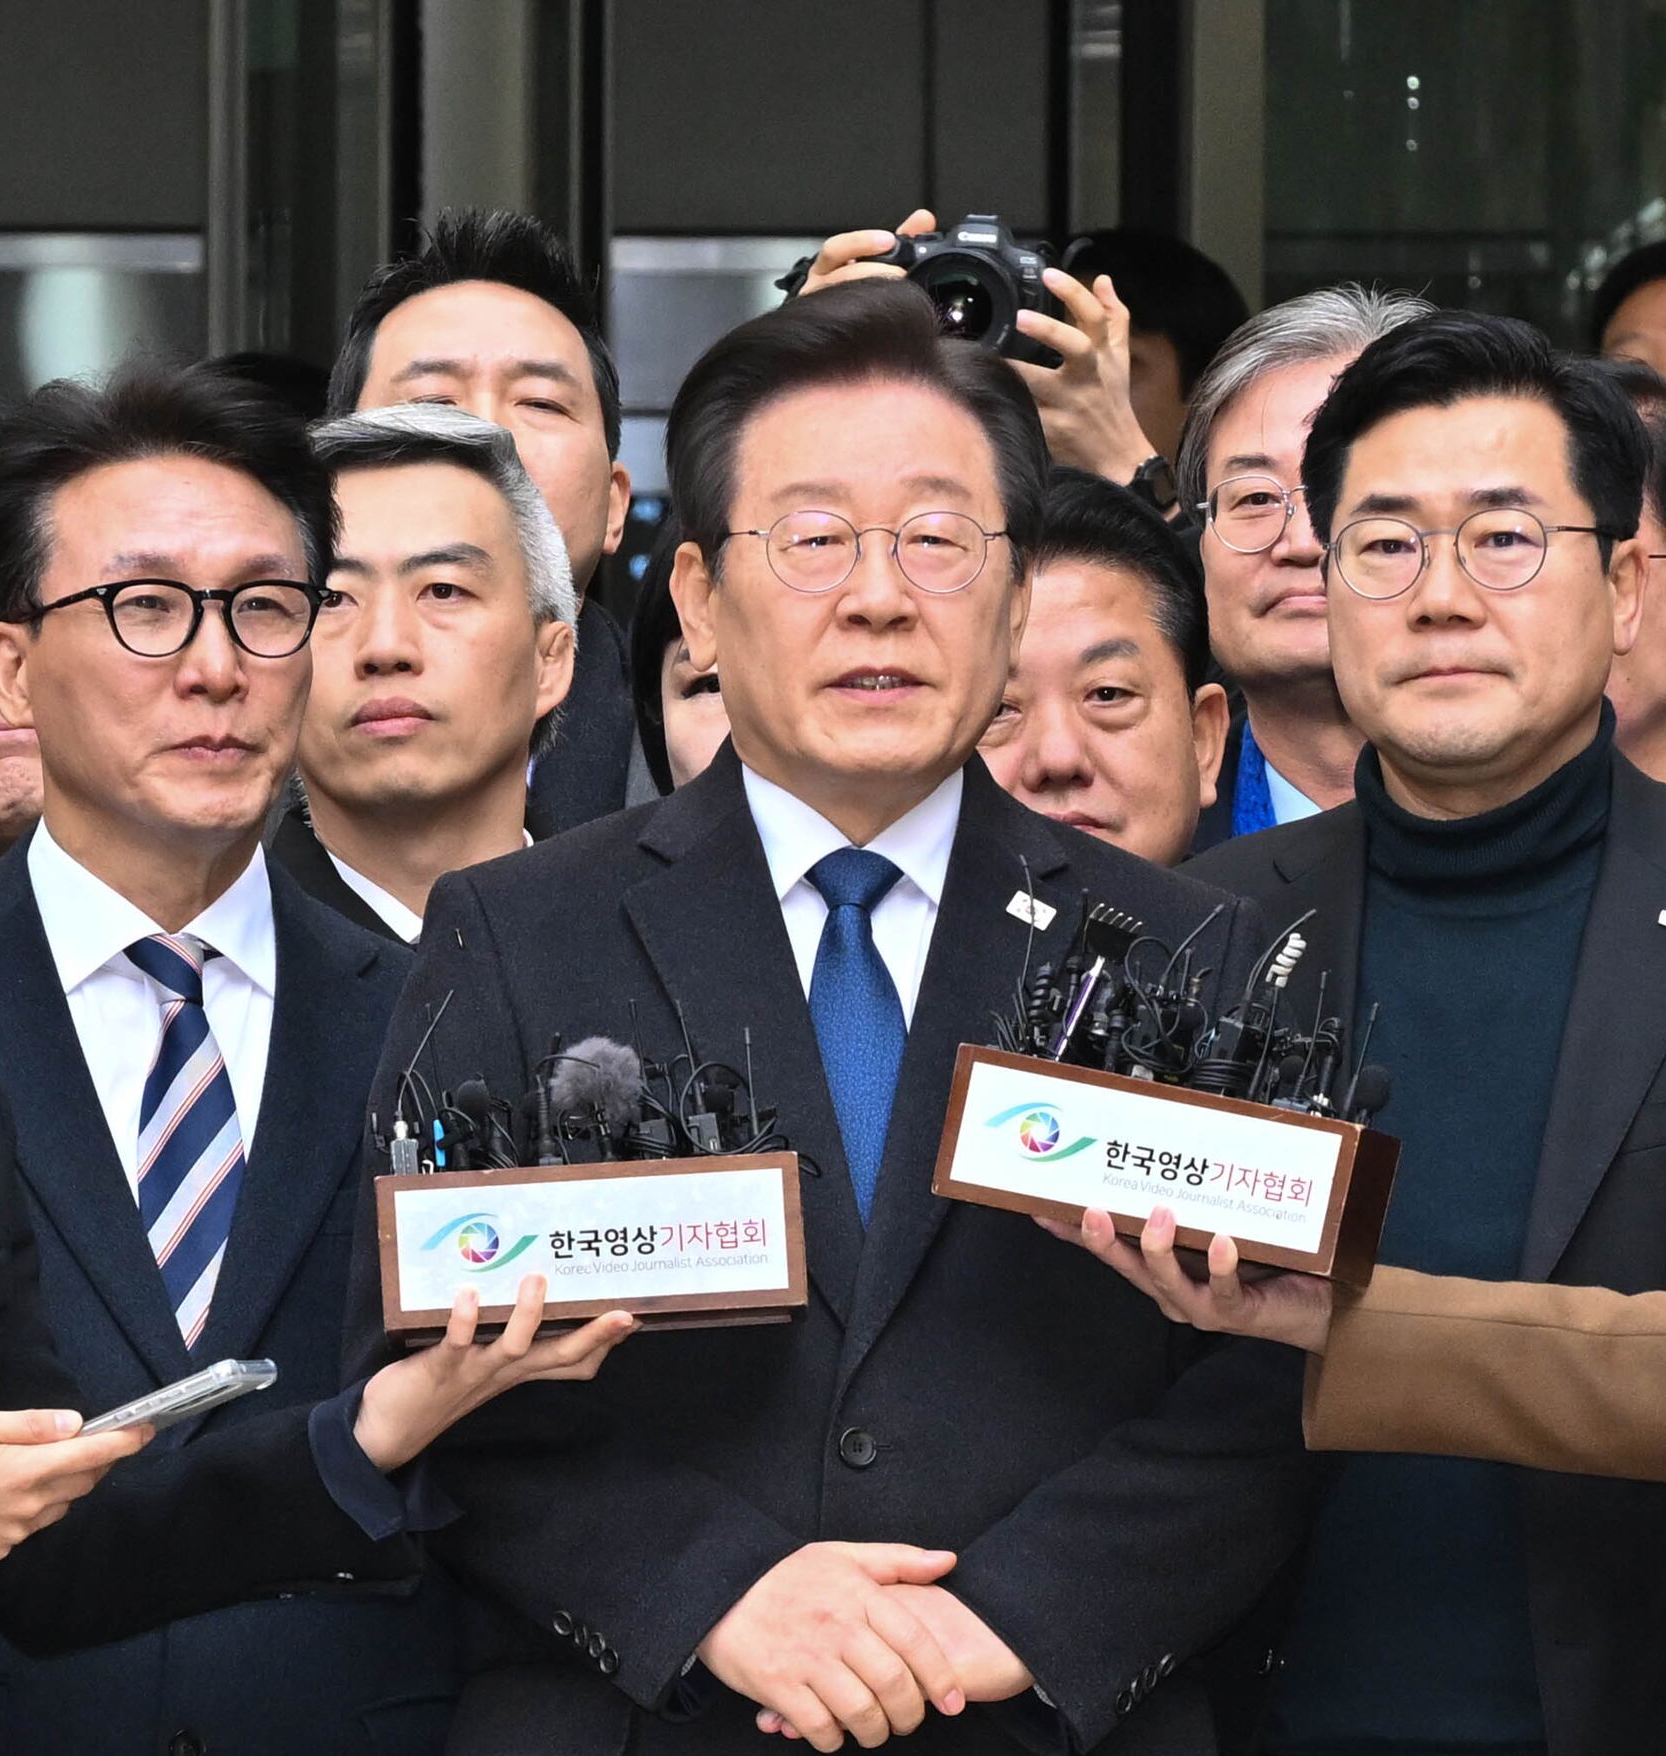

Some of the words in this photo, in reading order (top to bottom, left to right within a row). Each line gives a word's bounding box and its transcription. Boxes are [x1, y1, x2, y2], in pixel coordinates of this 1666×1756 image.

[1106, 1140, 1313, 1207] 한국영상기자협회
[1102, 1172, 1138, 1190] Korea
[1139, 1179, 1174, 1197] Video
[1176, 1188, 1234, 1209] Journalist
[1237, 1200, 1307, 1222] Association
[548, 1218, 766, 1260] 한국영상기자협회
[593, 1260, 629, 1274] Video
[632, 1255, 692, 1272] Journalist
[696, 1252, 768, 1267] Association
